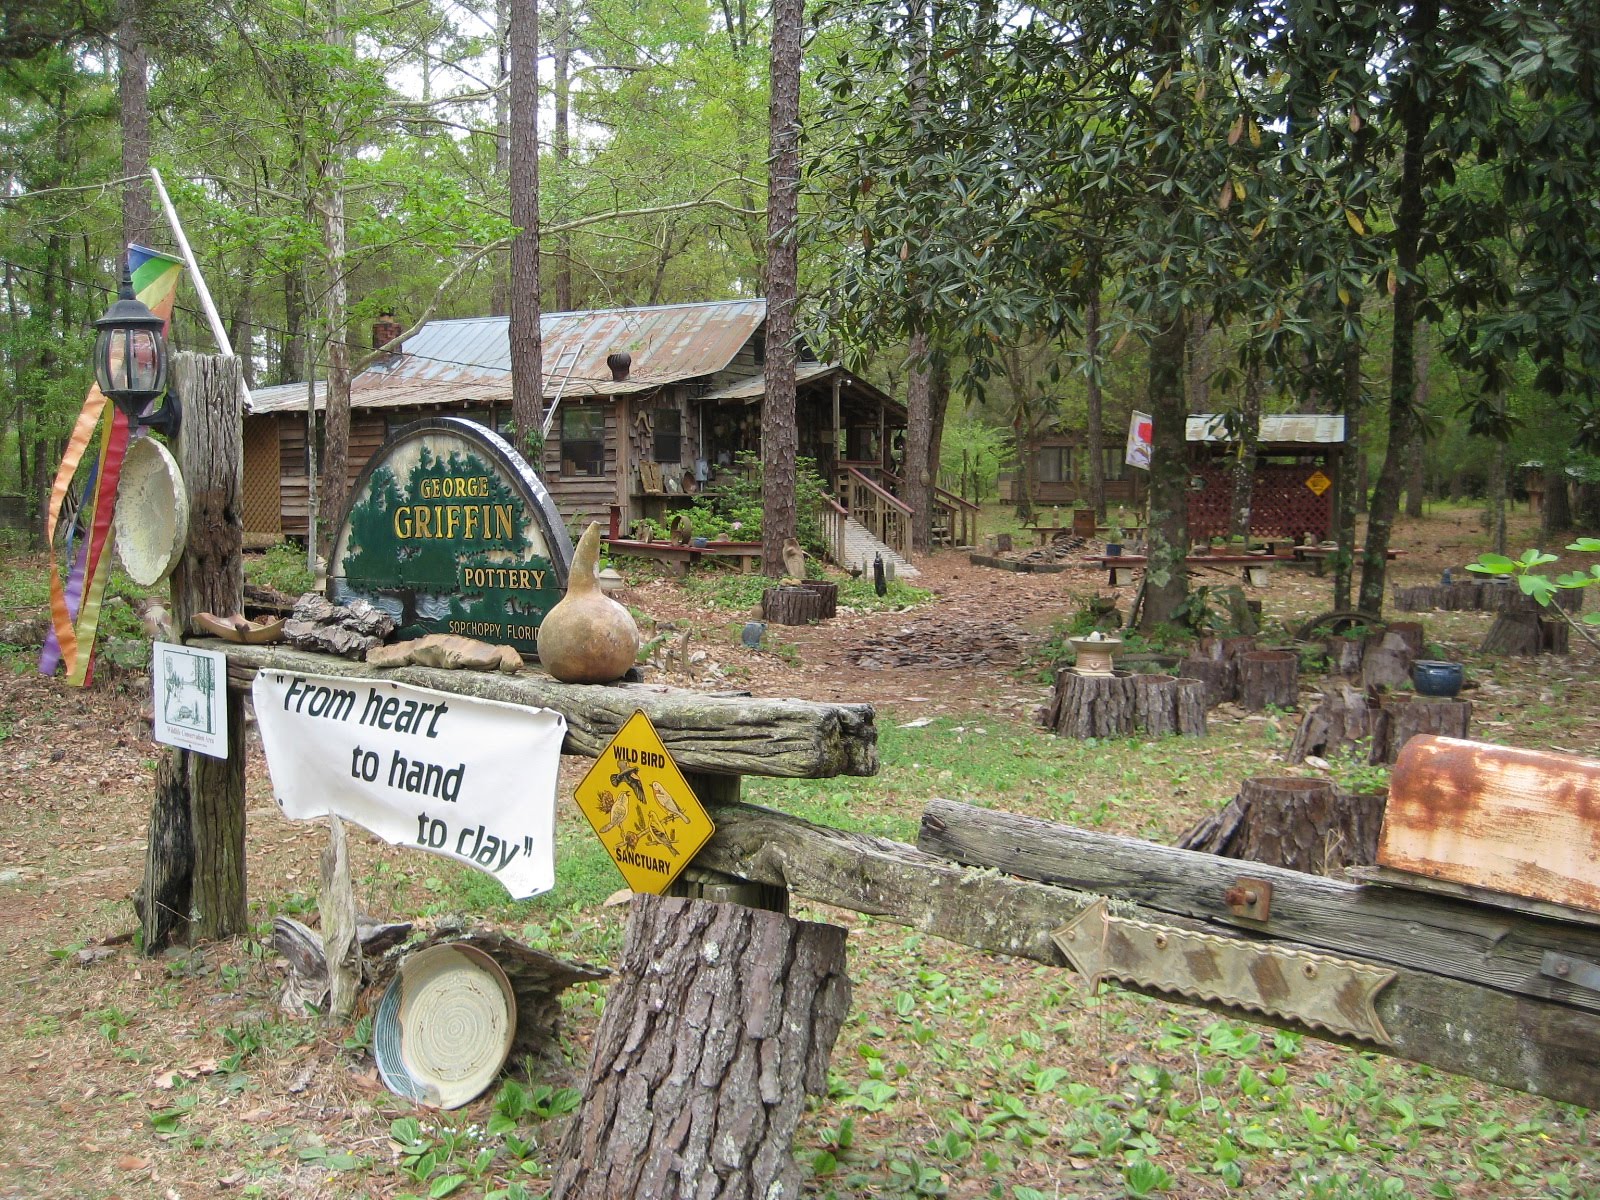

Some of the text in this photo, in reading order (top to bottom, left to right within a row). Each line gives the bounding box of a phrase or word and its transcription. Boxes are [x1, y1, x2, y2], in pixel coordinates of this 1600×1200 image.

[420, 476, 490, 499] GEORGE
[394, 504, 514, 540] GRIFFIN
[464, 568, 546, 590] POTTERY
[449, 620, 540, 641] SOPCHOPPY, FLORID
[359, 687, 449, 739] heart
[613, 745, 665, 769] WILD BIRD
[351, 745, 466, 803] to hand
[416, 811, 447, 849] to
[615, 847, 671, 876] SANCTUARY
